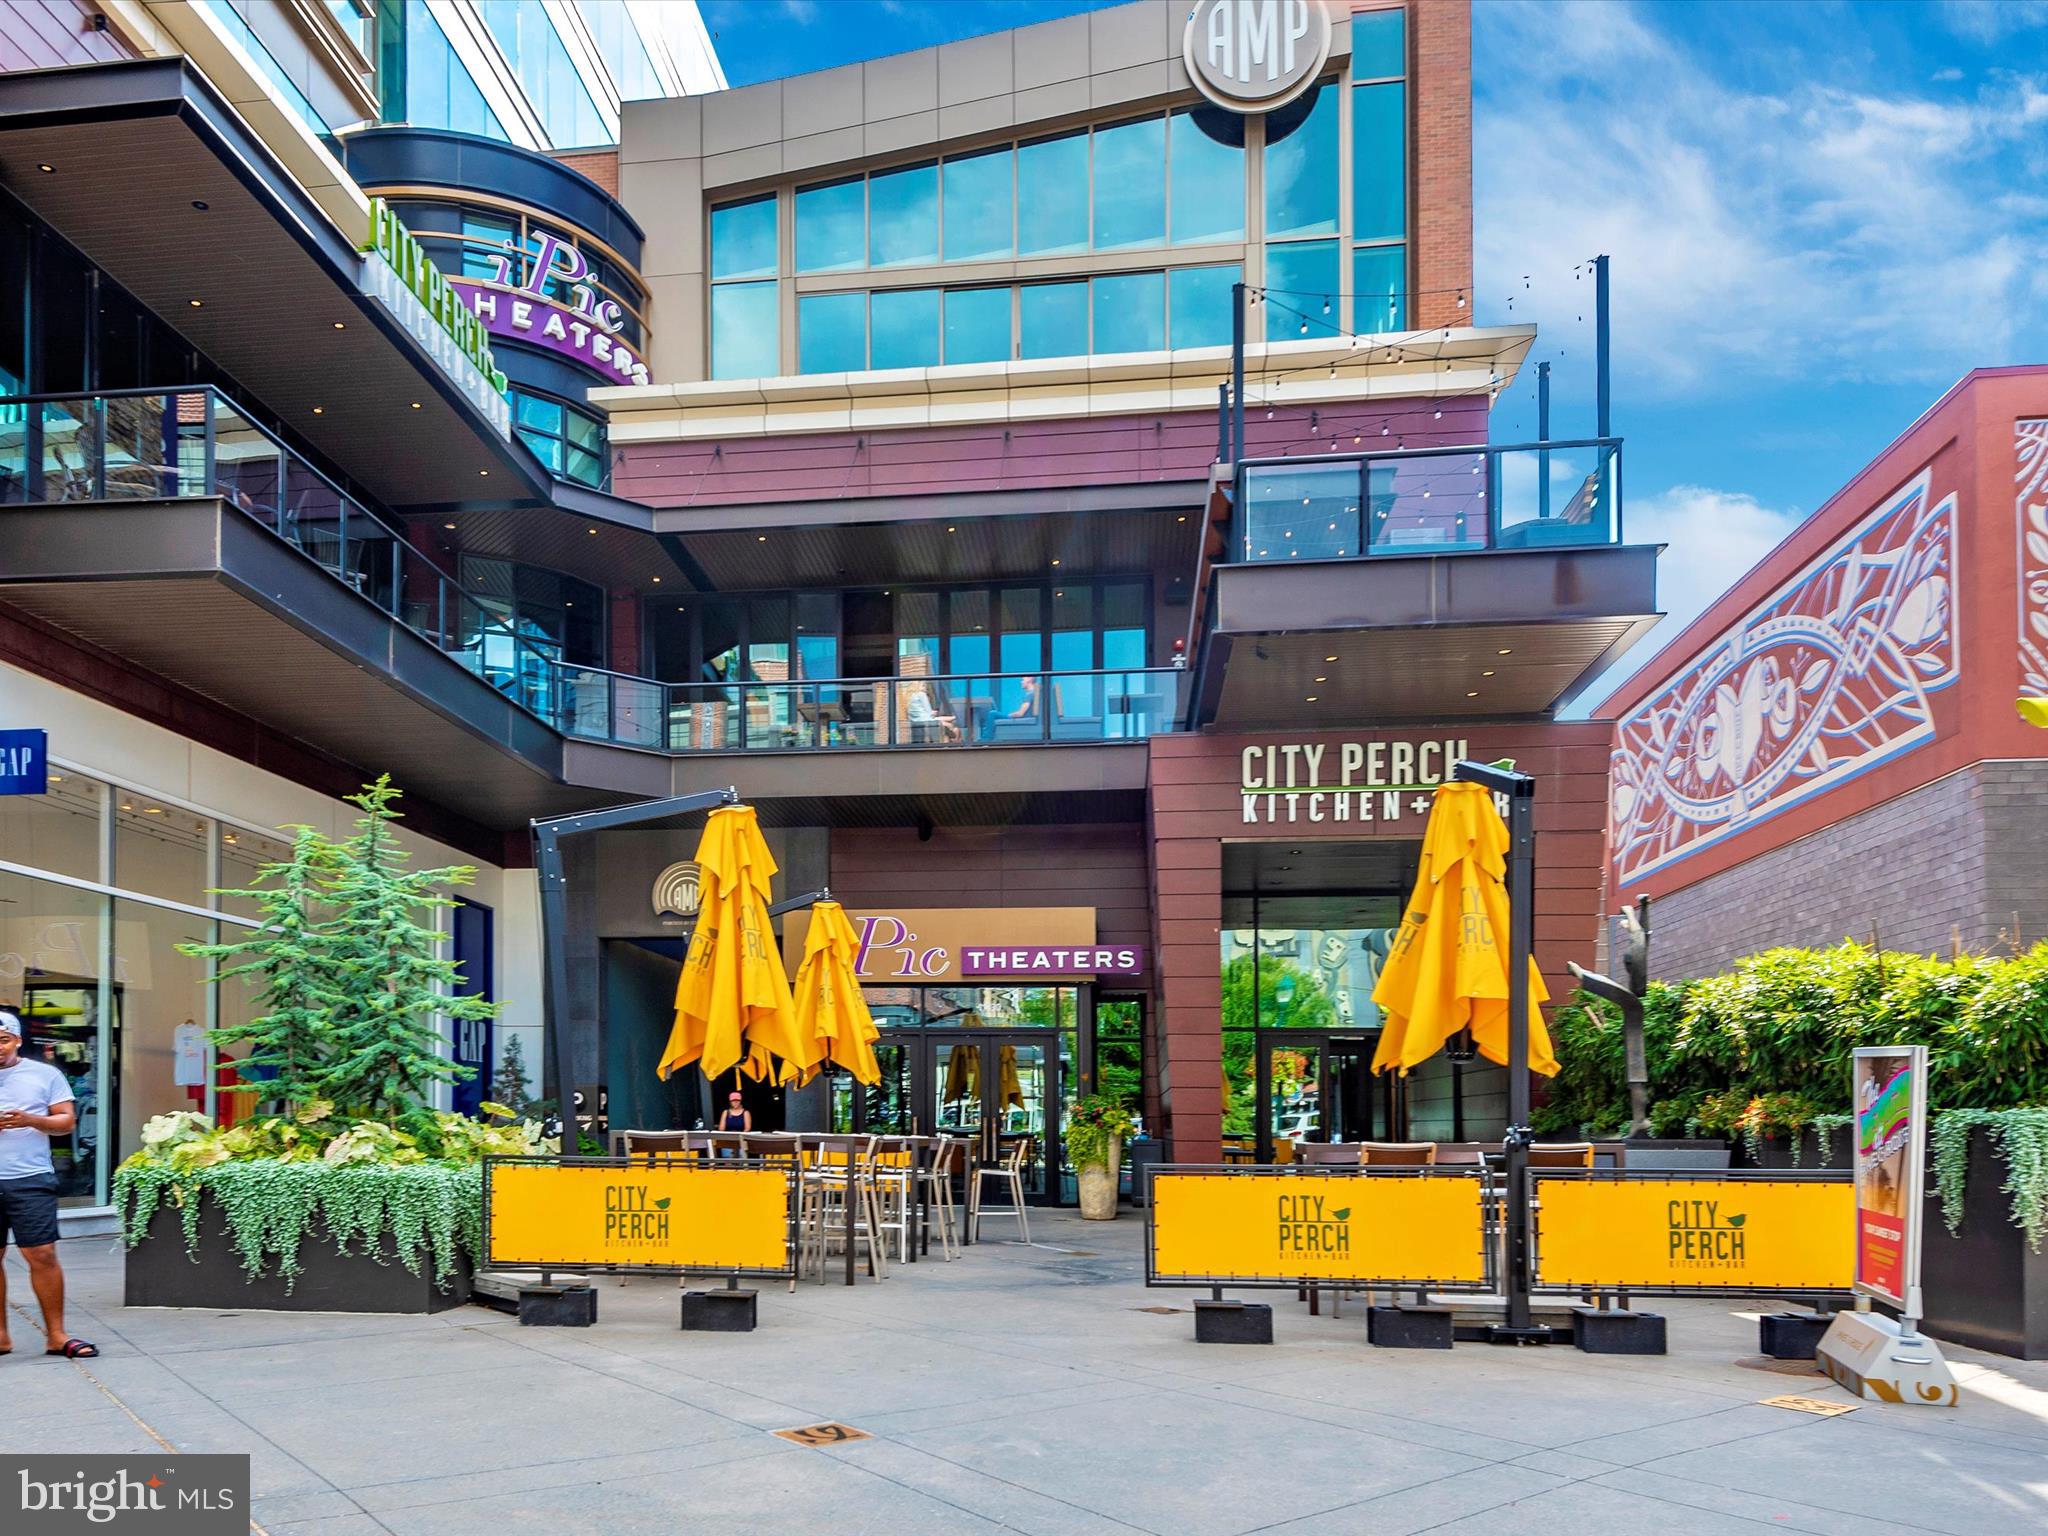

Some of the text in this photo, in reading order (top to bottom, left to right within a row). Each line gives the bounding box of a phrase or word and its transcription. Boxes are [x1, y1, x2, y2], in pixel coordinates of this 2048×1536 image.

[1207, 0, 1309, 83] AMP
[370, 197, 491, 379] CITY PERCH
[483, 229, 624, 335] iPic
[474, 292, 650, 386] HEATERS
[1242, 740, 1468, 788] CITY PERCH
[1242, 791, 1400, 824] KITCHEN
[854, 916, 1137, 976] Pic THEATERS
[460, 1020, 487, 1063] GAP
[606, 1185, 648, 1211] CITY
[1279, 1195, 1325, 1222] CITY
[1669, 1200, 1719, 1229] CITY
[606, 1213, 669, 1240] PERCH
[1279, 1224, 1350, 1252] PERCH
[1669, 1231, 1744, 1260] PERCH
